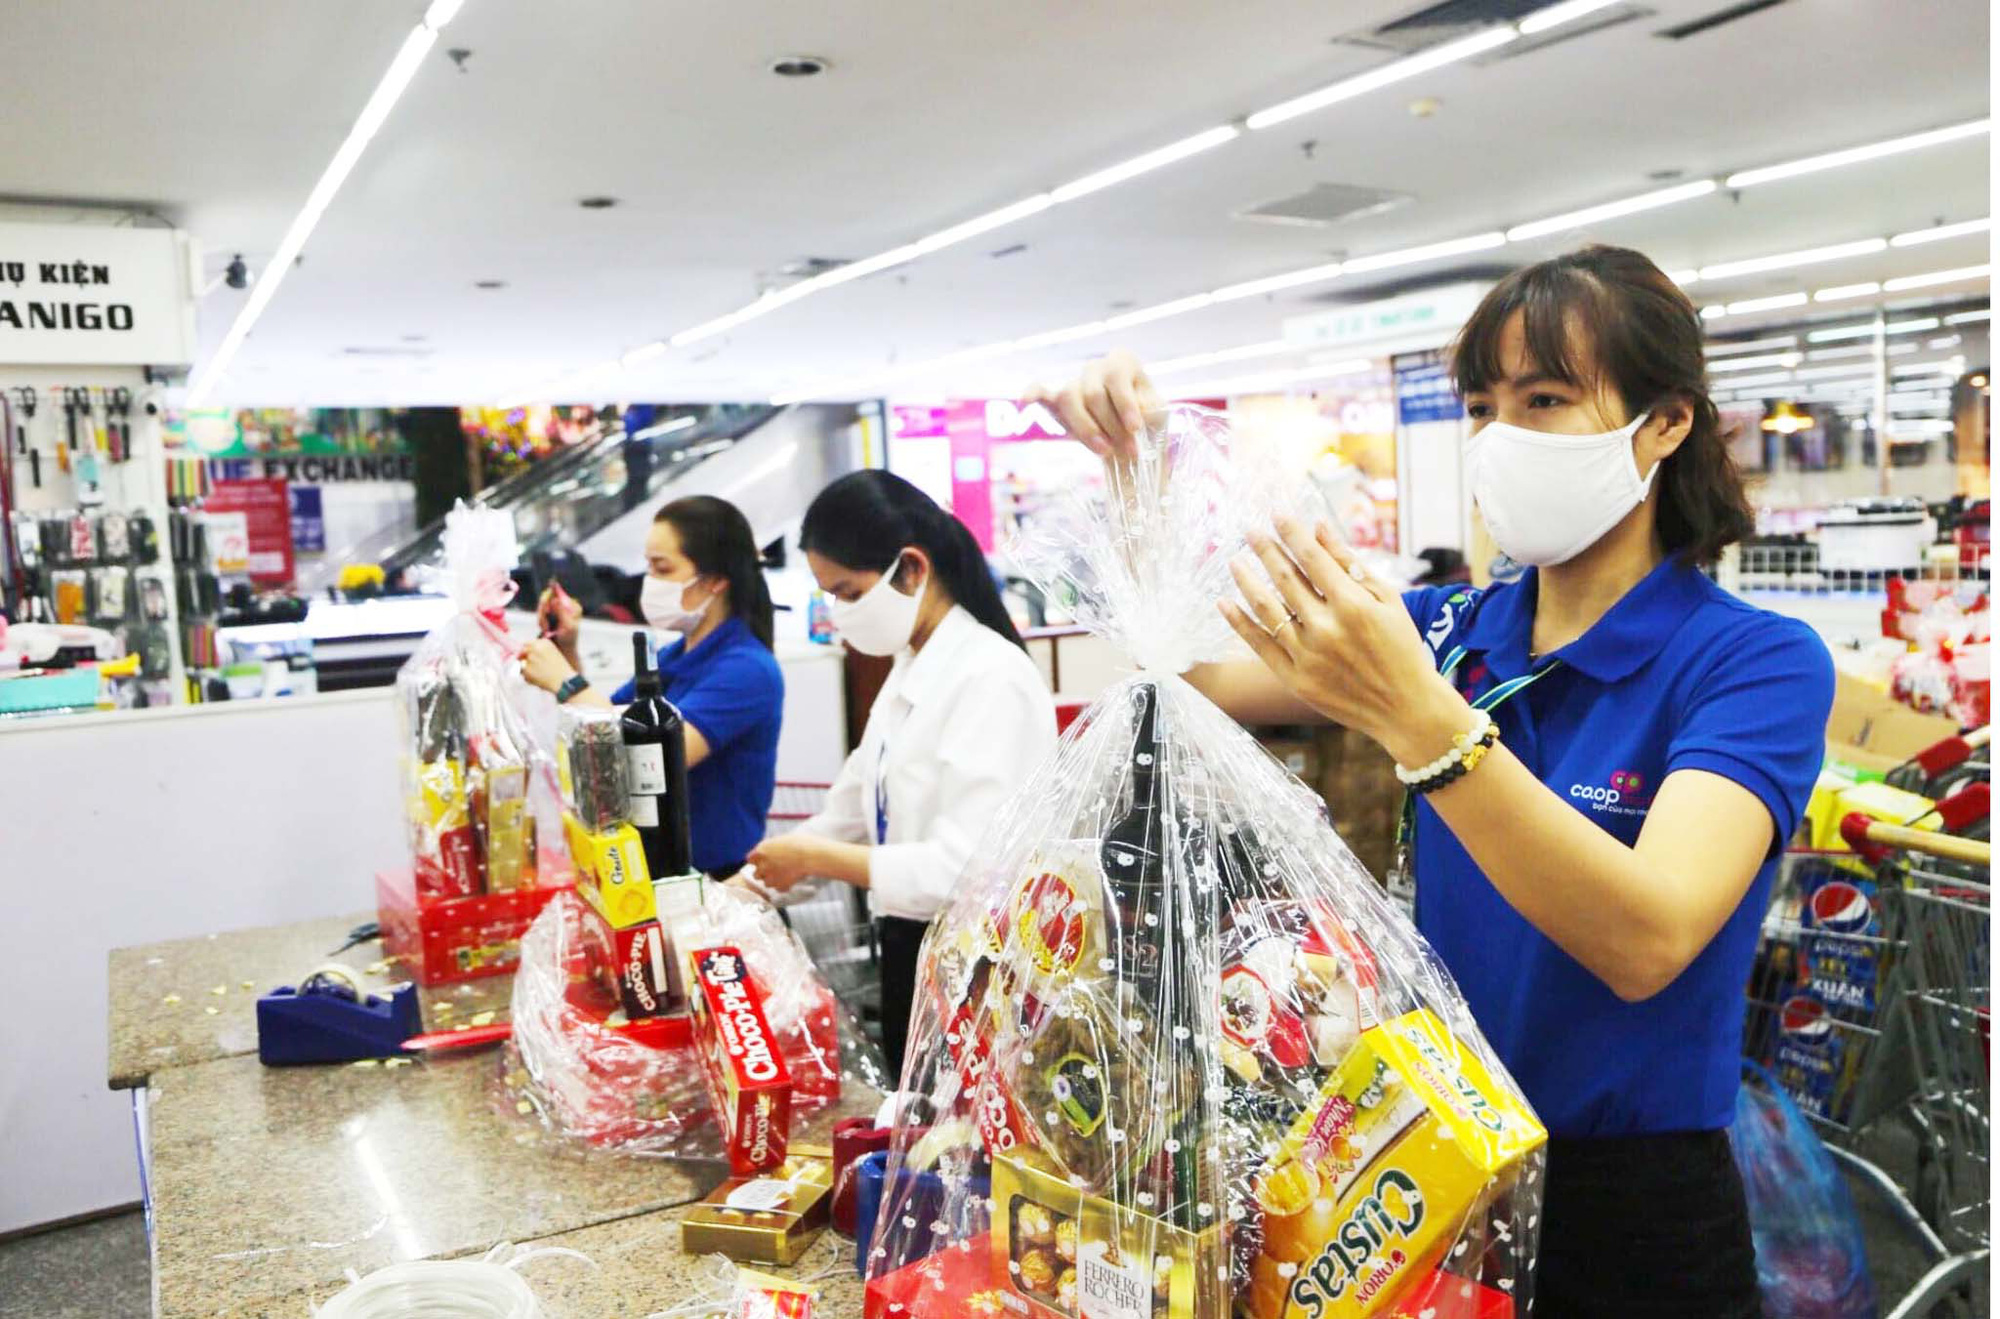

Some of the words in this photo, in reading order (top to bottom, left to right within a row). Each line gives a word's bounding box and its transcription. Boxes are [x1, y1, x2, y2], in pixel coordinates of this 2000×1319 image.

[39, 259, 109, 289] KIỆN
[264, 457, 417, 482] EXCHANGE
[1291, 1168, 1425, 1319] Custas
[1084, 1260, 1145, 1299] FERRERO
[1355, 1261, 1396, 1306] ORION
